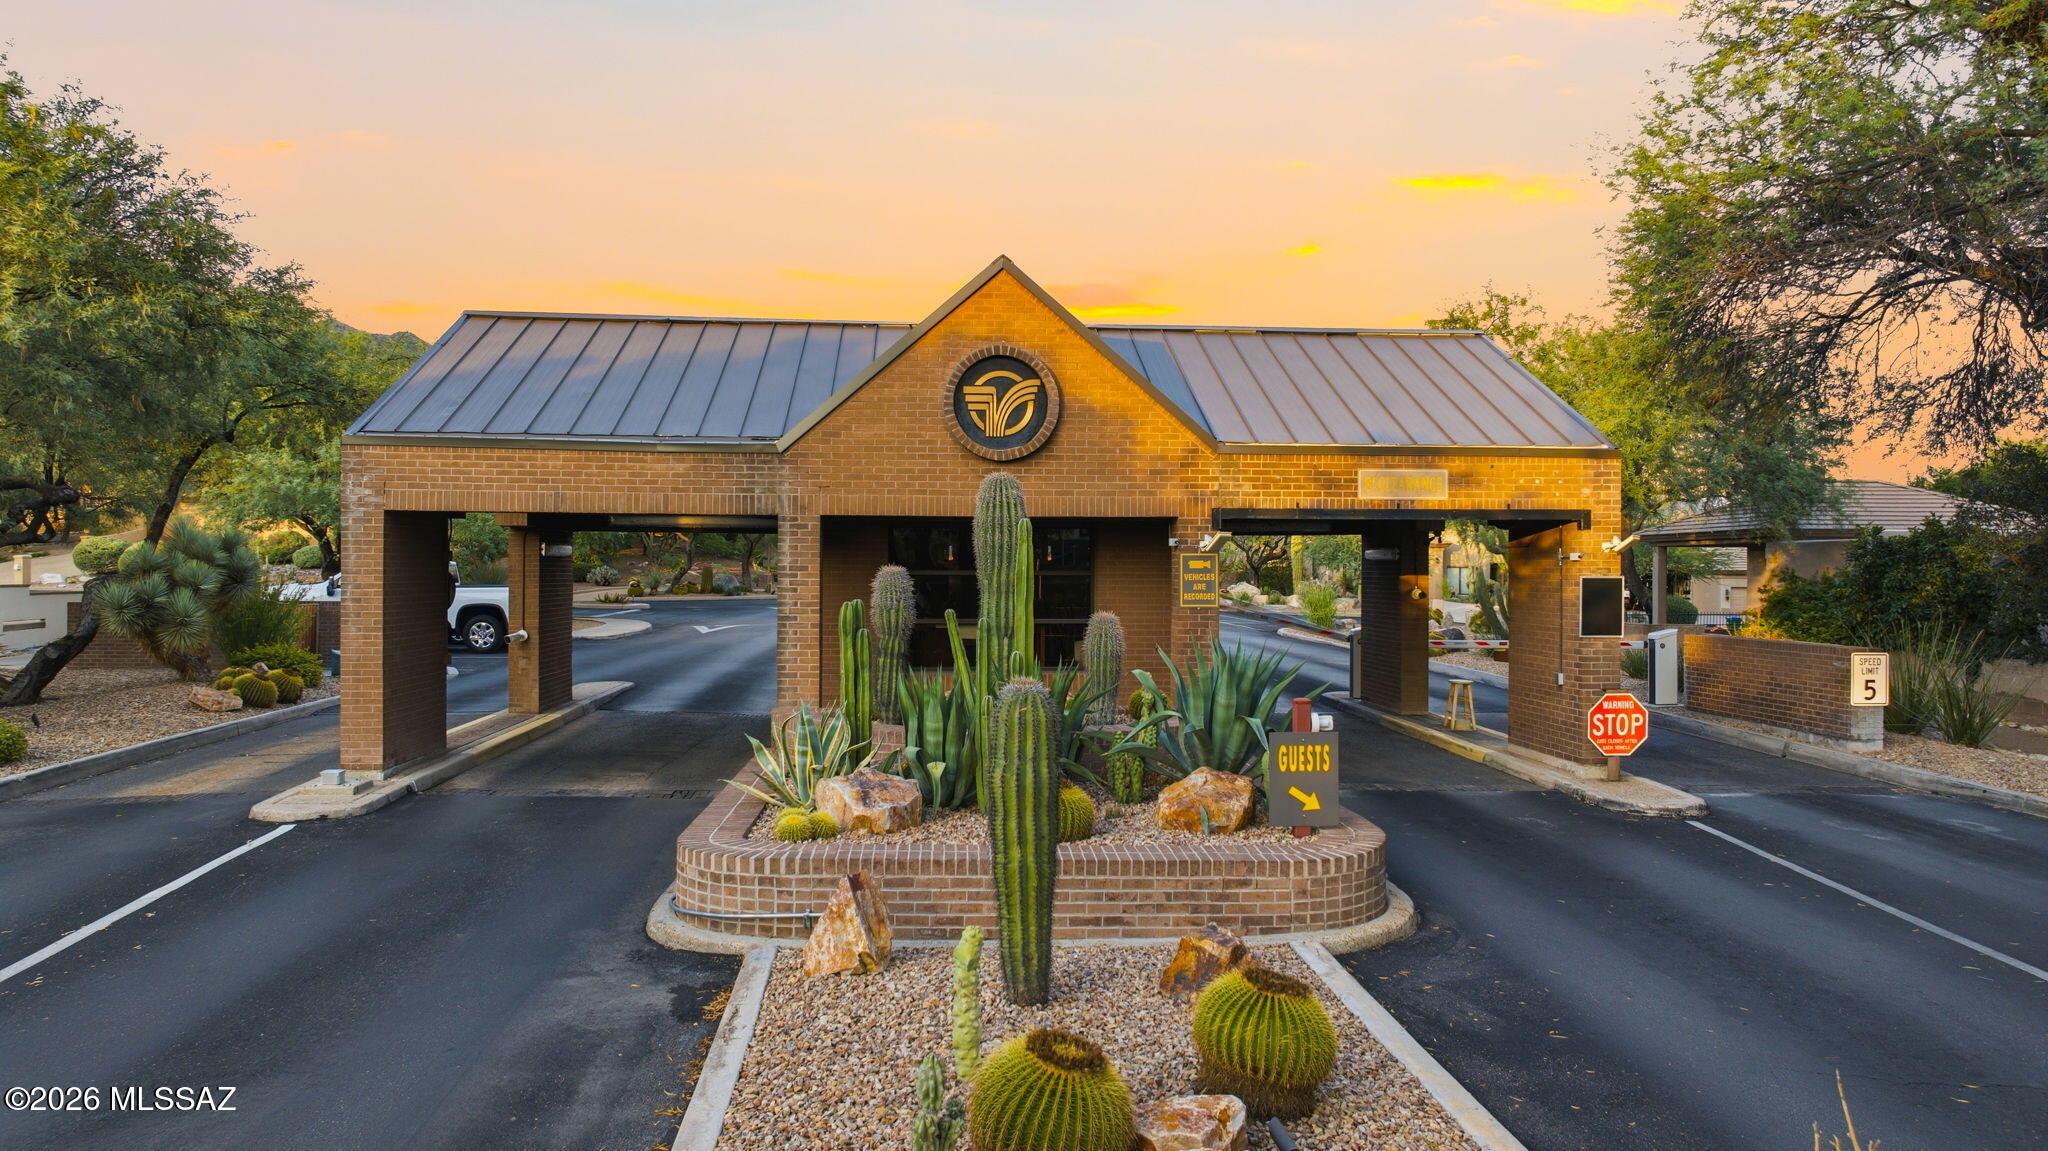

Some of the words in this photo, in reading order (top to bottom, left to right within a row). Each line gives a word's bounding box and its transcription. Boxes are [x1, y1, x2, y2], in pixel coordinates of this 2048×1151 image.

[1183, 573, 1217, 581] VEHICLES
[1859, 657, 1881, 665] SPEED
[1861, 667, 1879, 675] LIMIT
[1864, 679, 1876, 700] 5
[1602, 700, 1635, 709] WARNING
[1592, 713, 1644, 736] STOP
[1278, 744, 1330, 772] GUESTS
